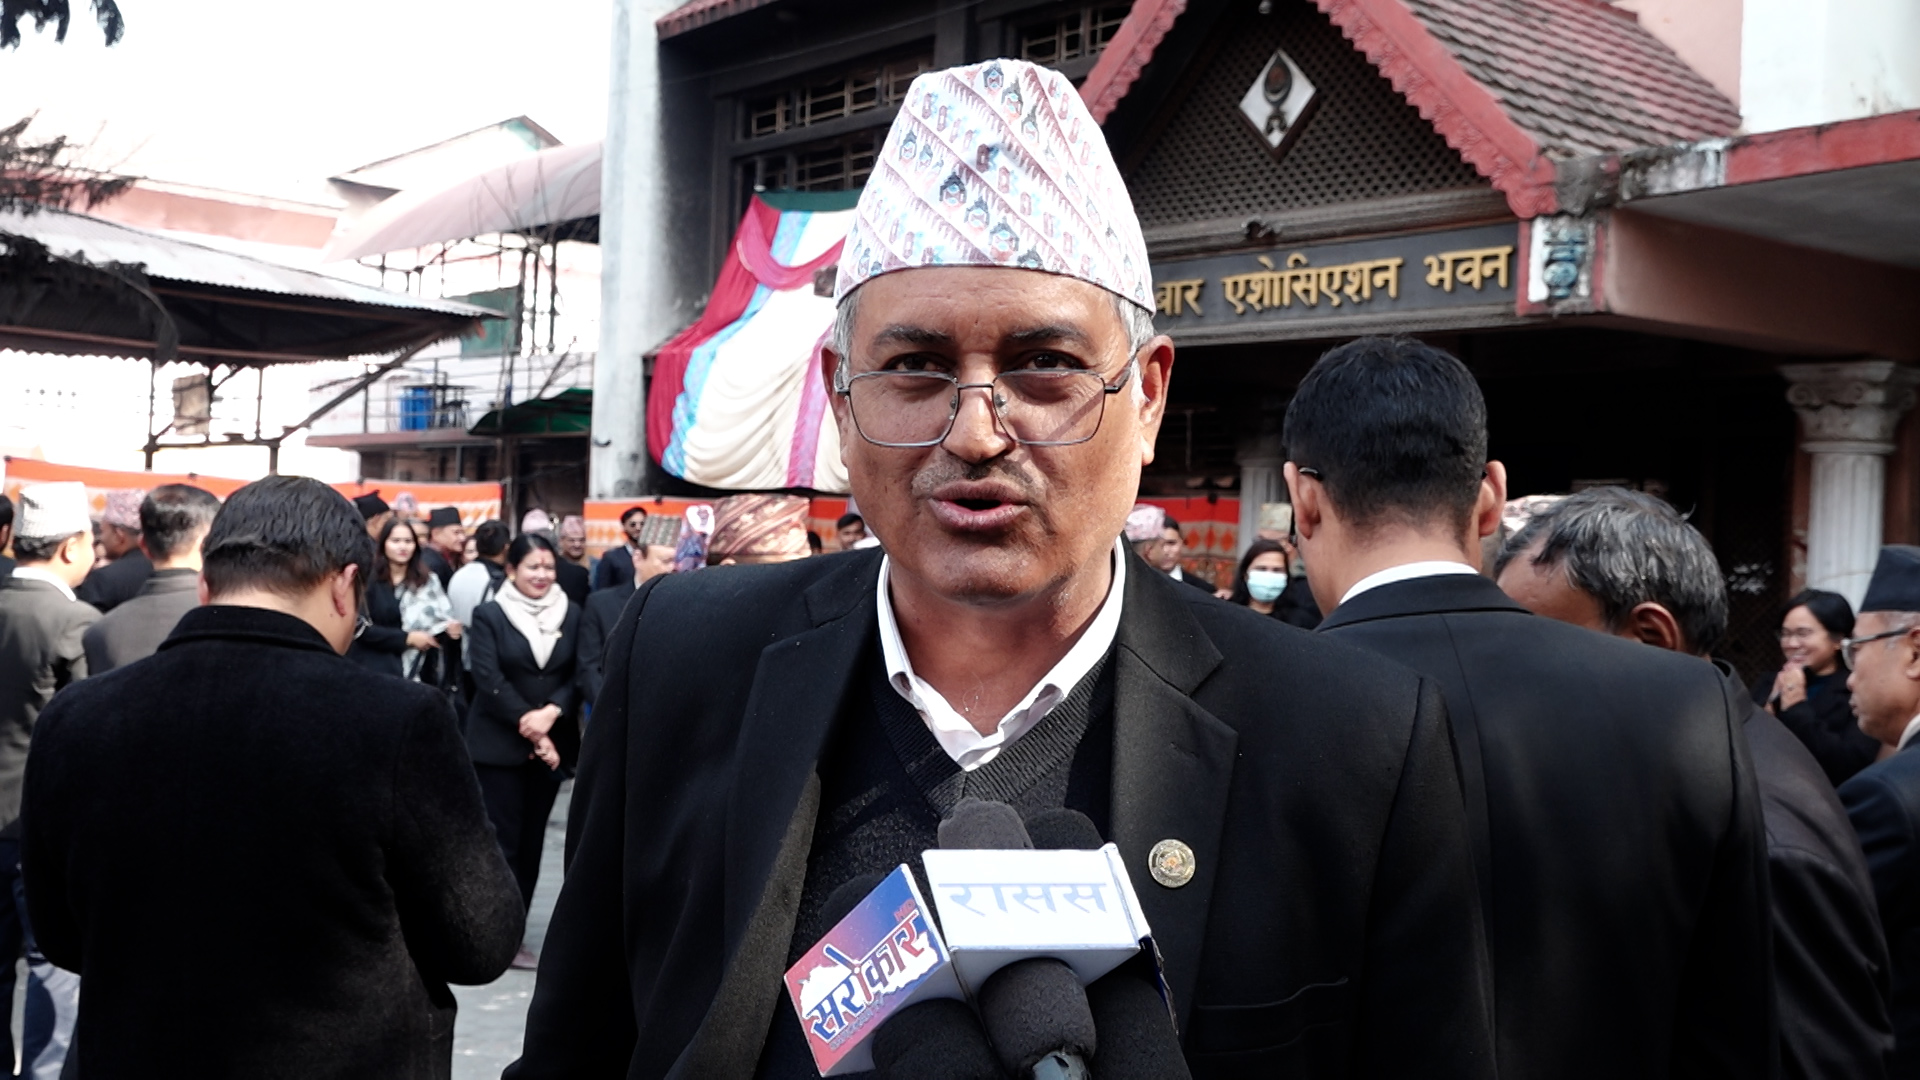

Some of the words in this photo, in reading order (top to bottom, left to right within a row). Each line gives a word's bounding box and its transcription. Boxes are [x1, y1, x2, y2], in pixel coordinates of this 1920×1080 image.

[1222, 253, 1404, 314] एशोसिएशन
[1424, 245, 1514, 293] भवन
[938, 883, 1107, 917] रासस
[804, 909, 926, 1042] सरोकार
